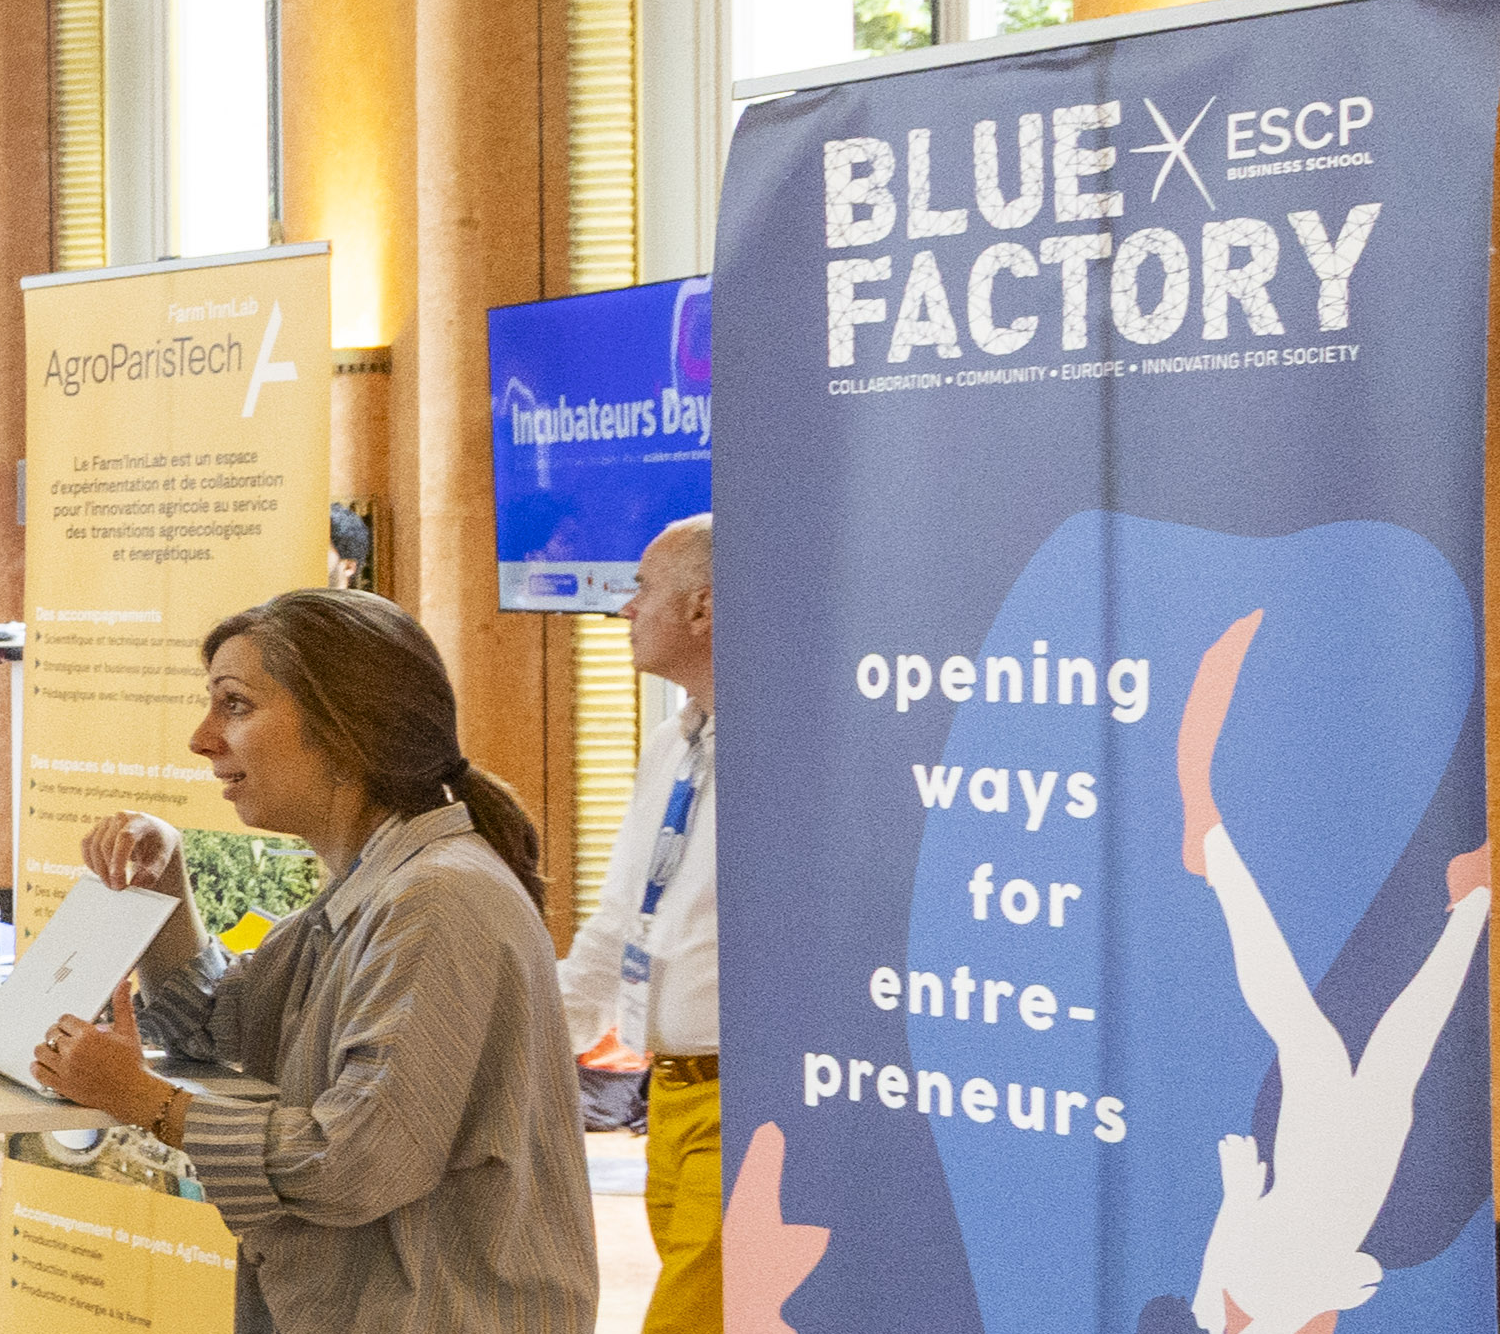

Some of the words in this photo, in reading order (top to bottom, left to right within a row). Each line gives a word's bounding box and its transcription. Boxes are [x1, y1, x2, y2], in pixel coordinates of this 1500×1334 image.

[823, 99, 1123, 250] BLUE
[1226, 96, 1374, 160] ESCP
[1227, 160, 1302, 181] BUSINESS
[1306, 150, 1374, 172] SCHOOL
[168, 296, 258, 323] Farm'InnLab
[826, 202, 1383, 368] FACTORY
[44, 333, 242, 396] AgroParisTech
[828, 372, 942, 396] COLLABORATION
[956, 366, 1047, 387] COMMUNITY
[1061, 360, 1125, 380] EUROPE
[1142, 352, 1240, 375] INNOVATING
[1244, 349, 1278, 367] FOR
[1282, 344, 1360, 365] SOCIETY
[512, 394, 656, 446] Incubateurs
[662, 387, 712, 447] Day
[74, 456, 88, 472] Le
[171, 451, 191, 467] est
[195, 453, 211, 467] un
[215, 451, 258, 470] espace
[162, 475, 176, 490] et
[180, 474, 197, 490] de
[200, 472, 283, 490] collaboration
[53, 504, 82, 520] pour
[84, 499, 155, 517] l'innovation
[158, 497, 210, 518] agricole
[214, 500, 229, 513] au
[232, 495, 278, 512] service
[66, 524, 87, 539] des
[91, 522, 155, 538] transitions
[112, 548, 124, 561] et
[856, 640, 1150, 723] opening
[911, 764, 1098, 831] ways
[969, 863, 1081, 928] for
[870, 967, 1095, 1031] entre-
[803, 1052, 1127, 1143] preneurs
